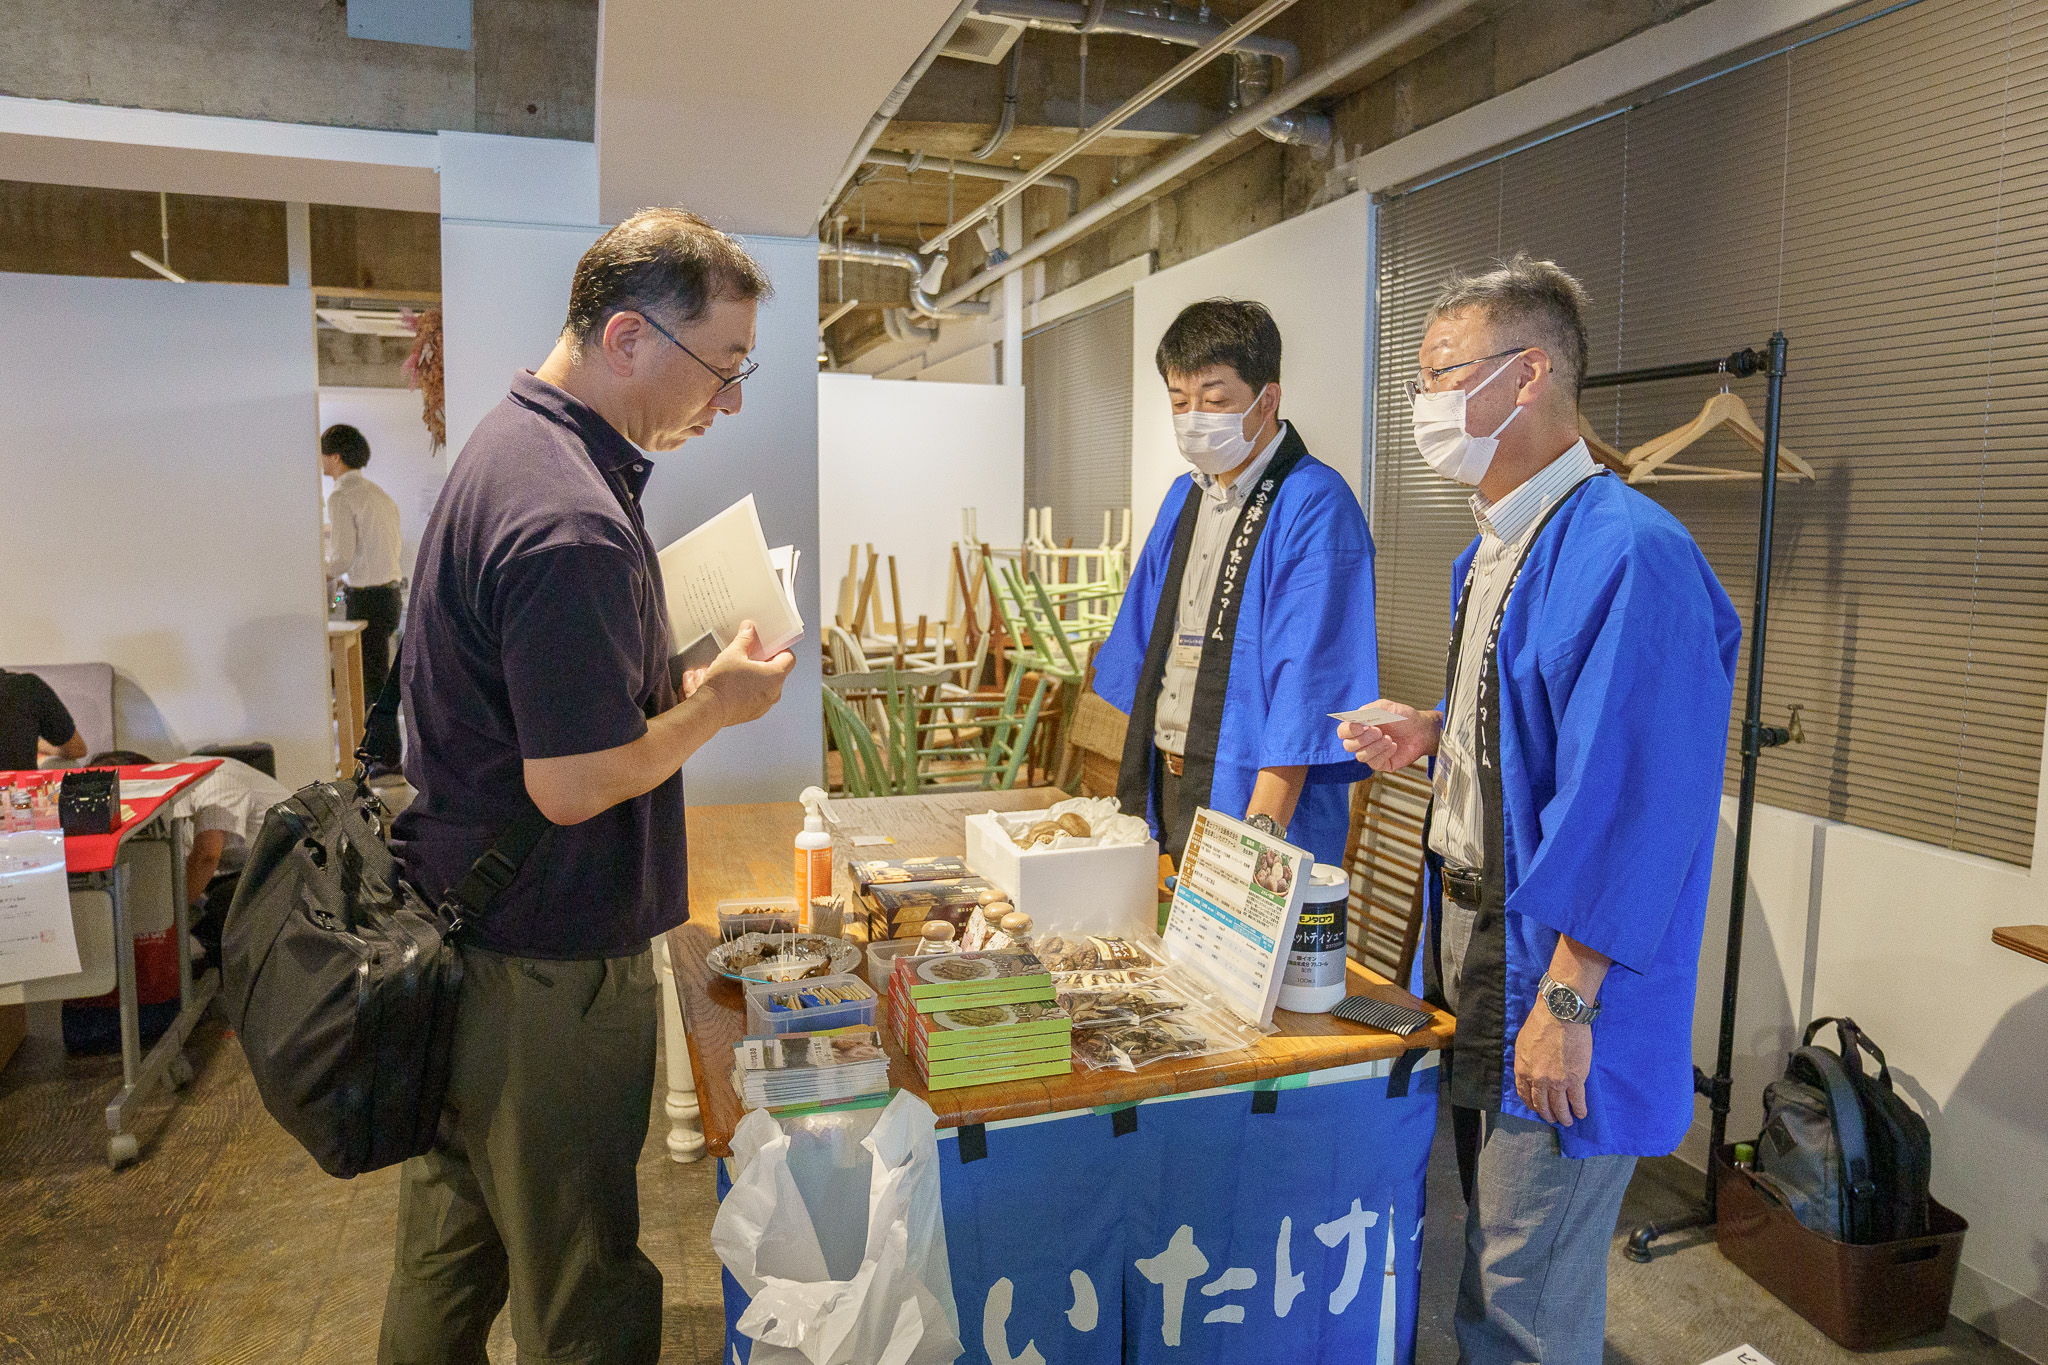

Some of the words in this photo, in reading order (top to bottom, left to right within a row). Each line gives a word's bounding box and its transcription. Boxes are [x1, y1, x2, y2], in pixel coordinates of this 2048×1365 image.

[1299, 915, 1333, 924] モノタロウ
